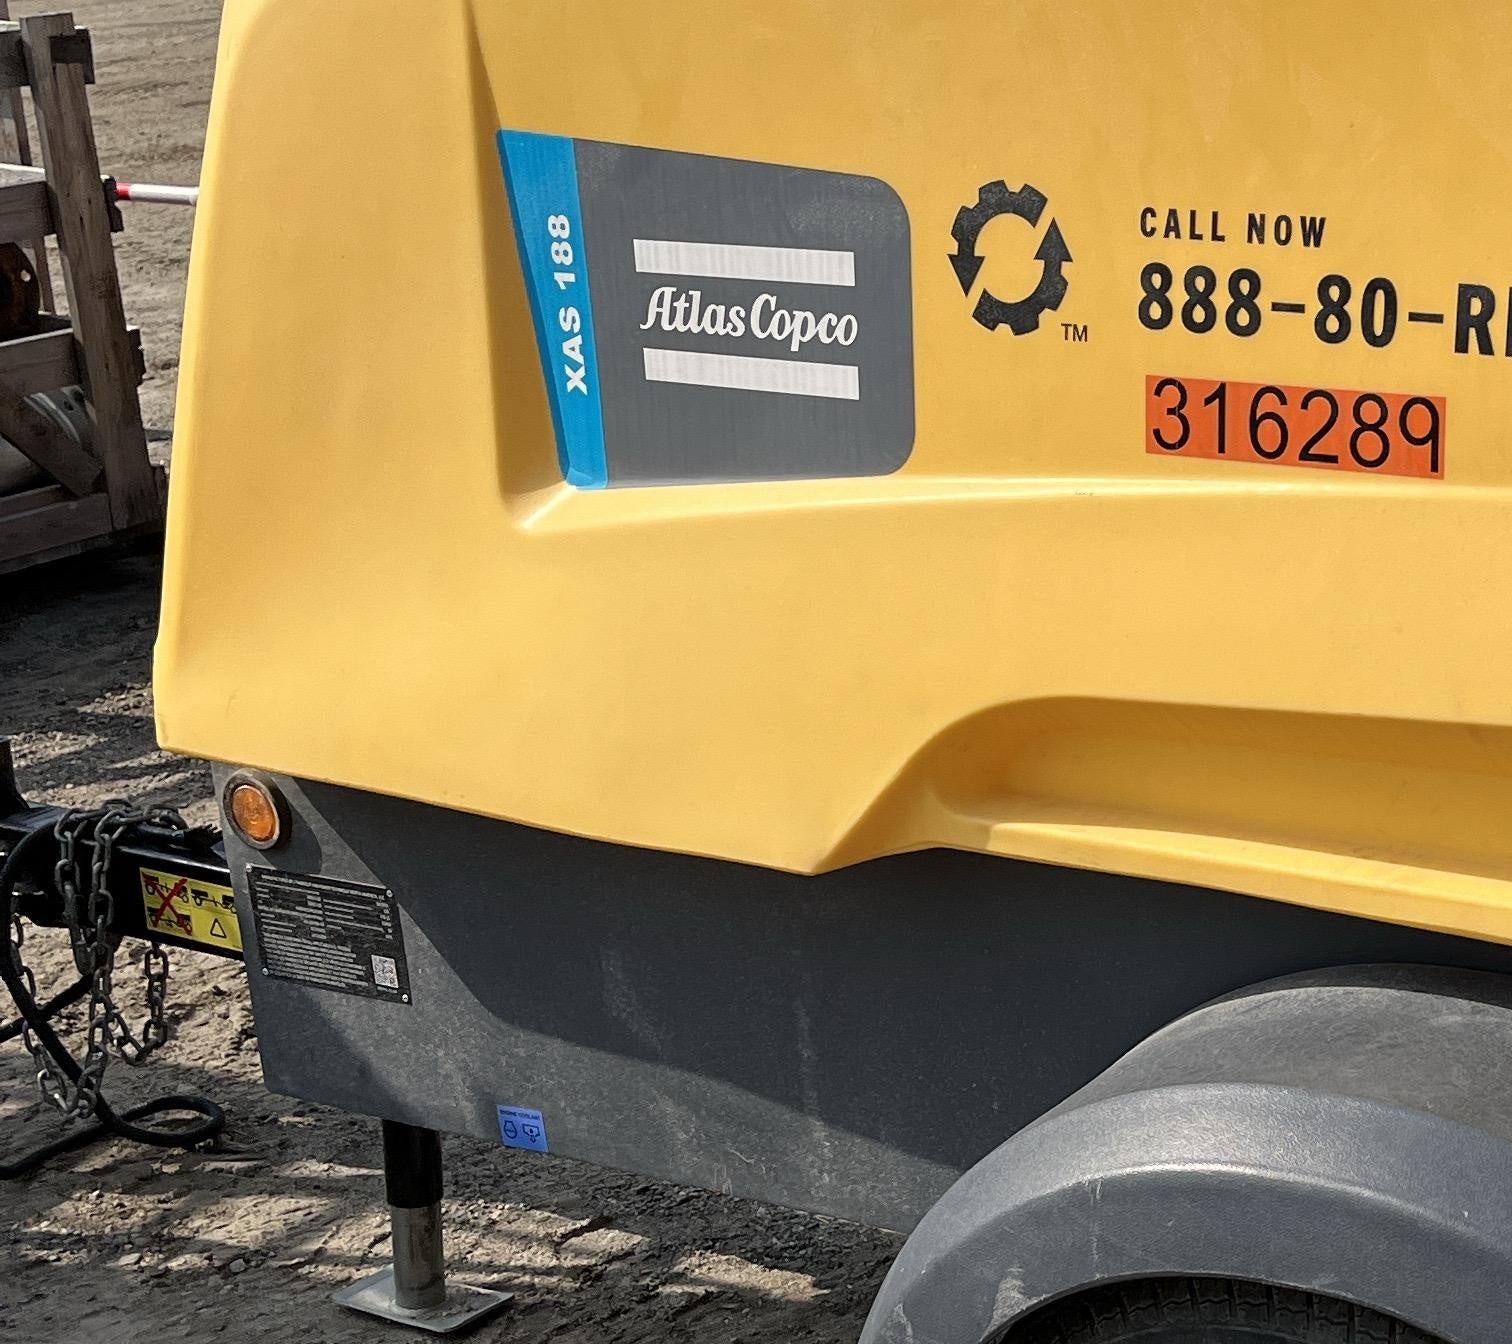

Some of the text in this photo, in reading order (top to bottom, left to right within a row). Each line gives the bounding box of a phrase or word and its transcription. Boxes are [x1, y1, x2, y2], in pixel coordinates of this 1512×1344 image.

[1140, 207, 1327, 248] CALL NOW
[547, 214, 588, 396] XAS 188
[640, 286, 858, 352] Atlas Copco
[1061, 323, 1088, 343] TM
[1152, 377, 1439, 473] 316289
